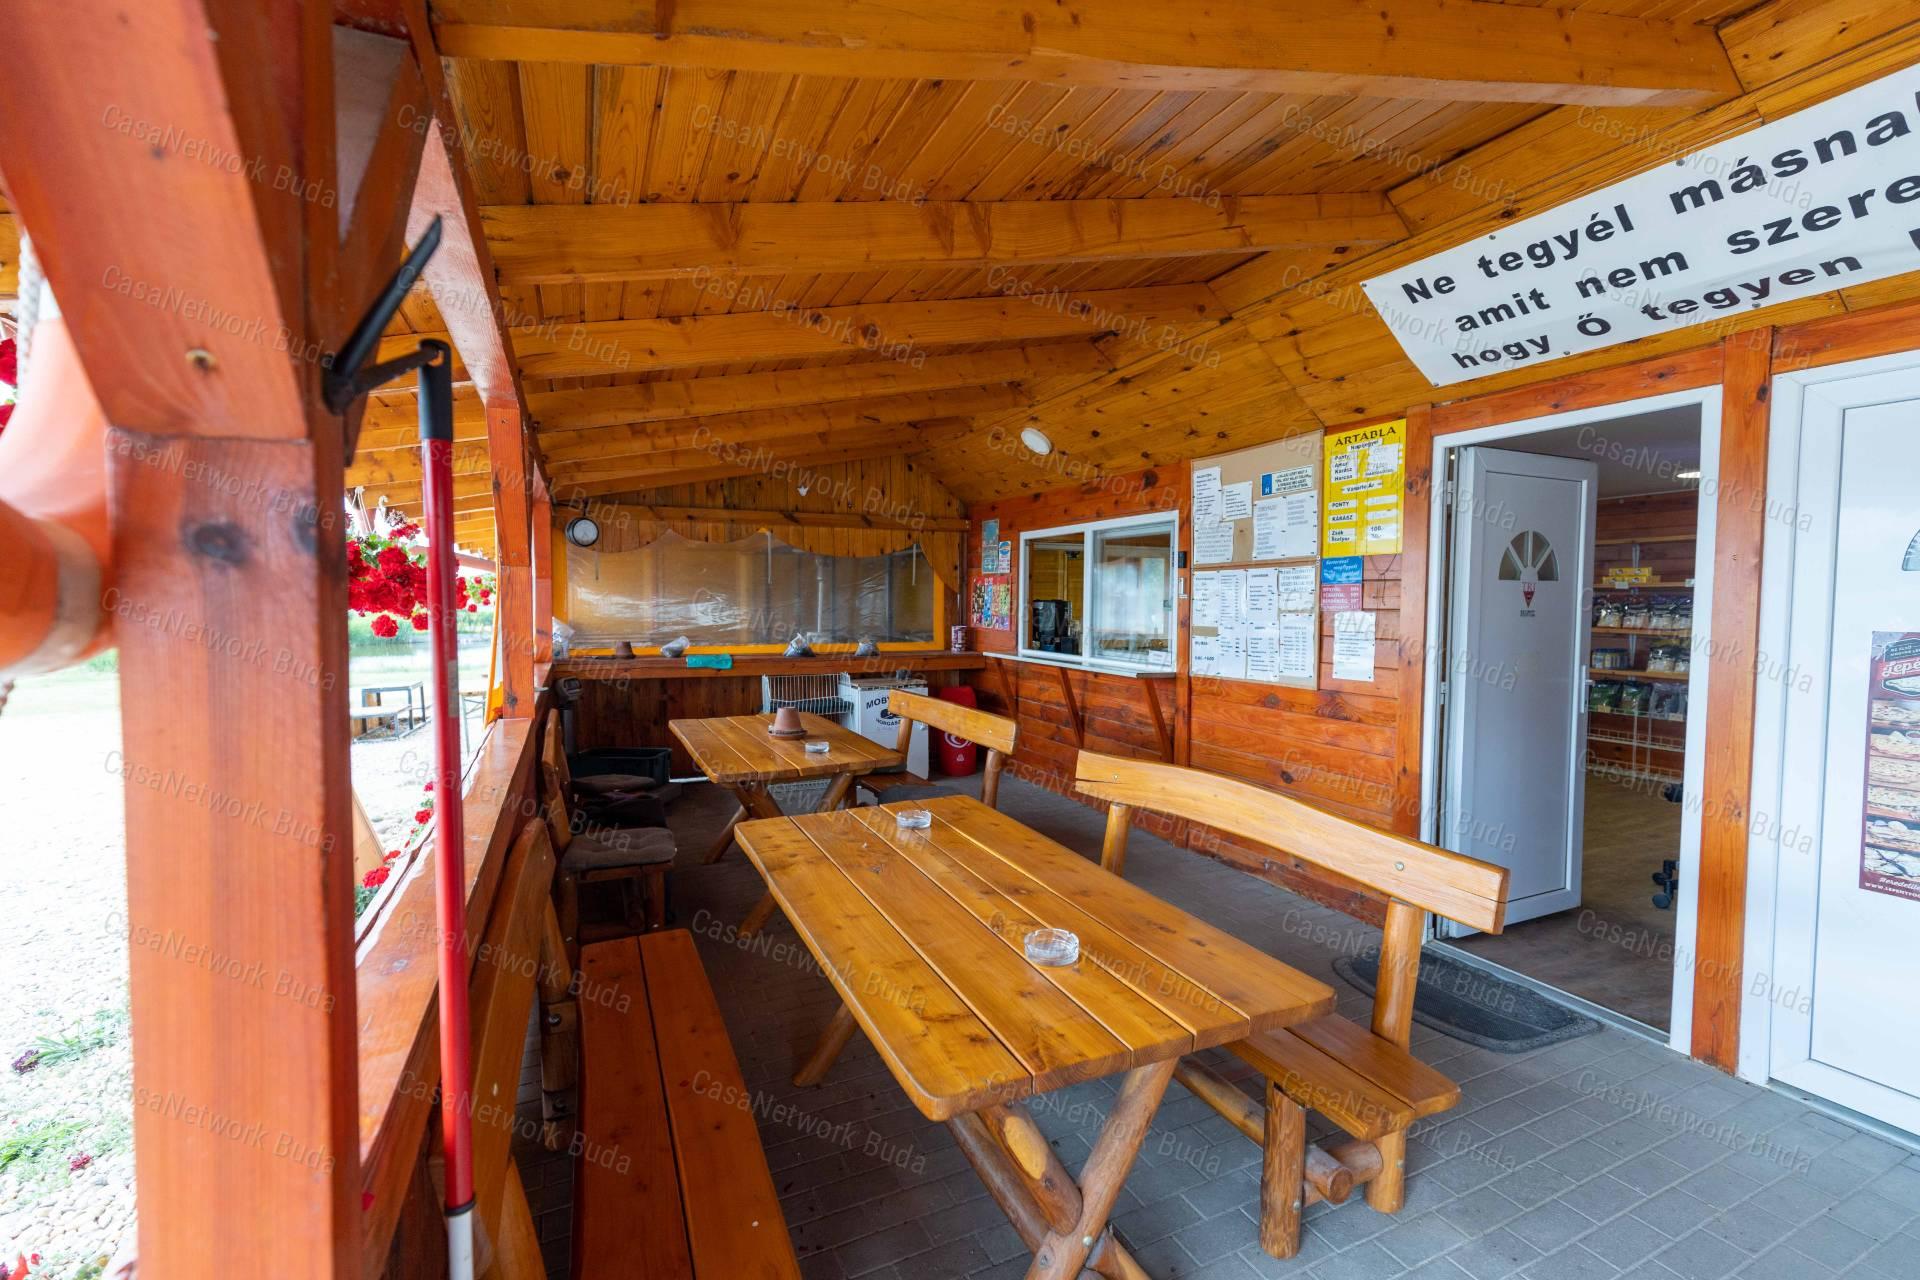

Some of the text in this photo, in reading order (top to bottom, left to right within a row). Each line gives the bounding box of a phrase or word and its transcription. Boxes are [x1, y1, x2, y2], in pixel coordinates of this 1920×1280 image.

[1401, 275, 1456, 304] Ne
[1477, 203, 1635, 278] tegyél
[1455, 288, 1551, 332] amit
[1575, 252, 1689, 299] nem
[1451, 256, 1863, 369] hogy Ő tegyen
[1335, 426, 1397, 447] ÁRTÁBLA
